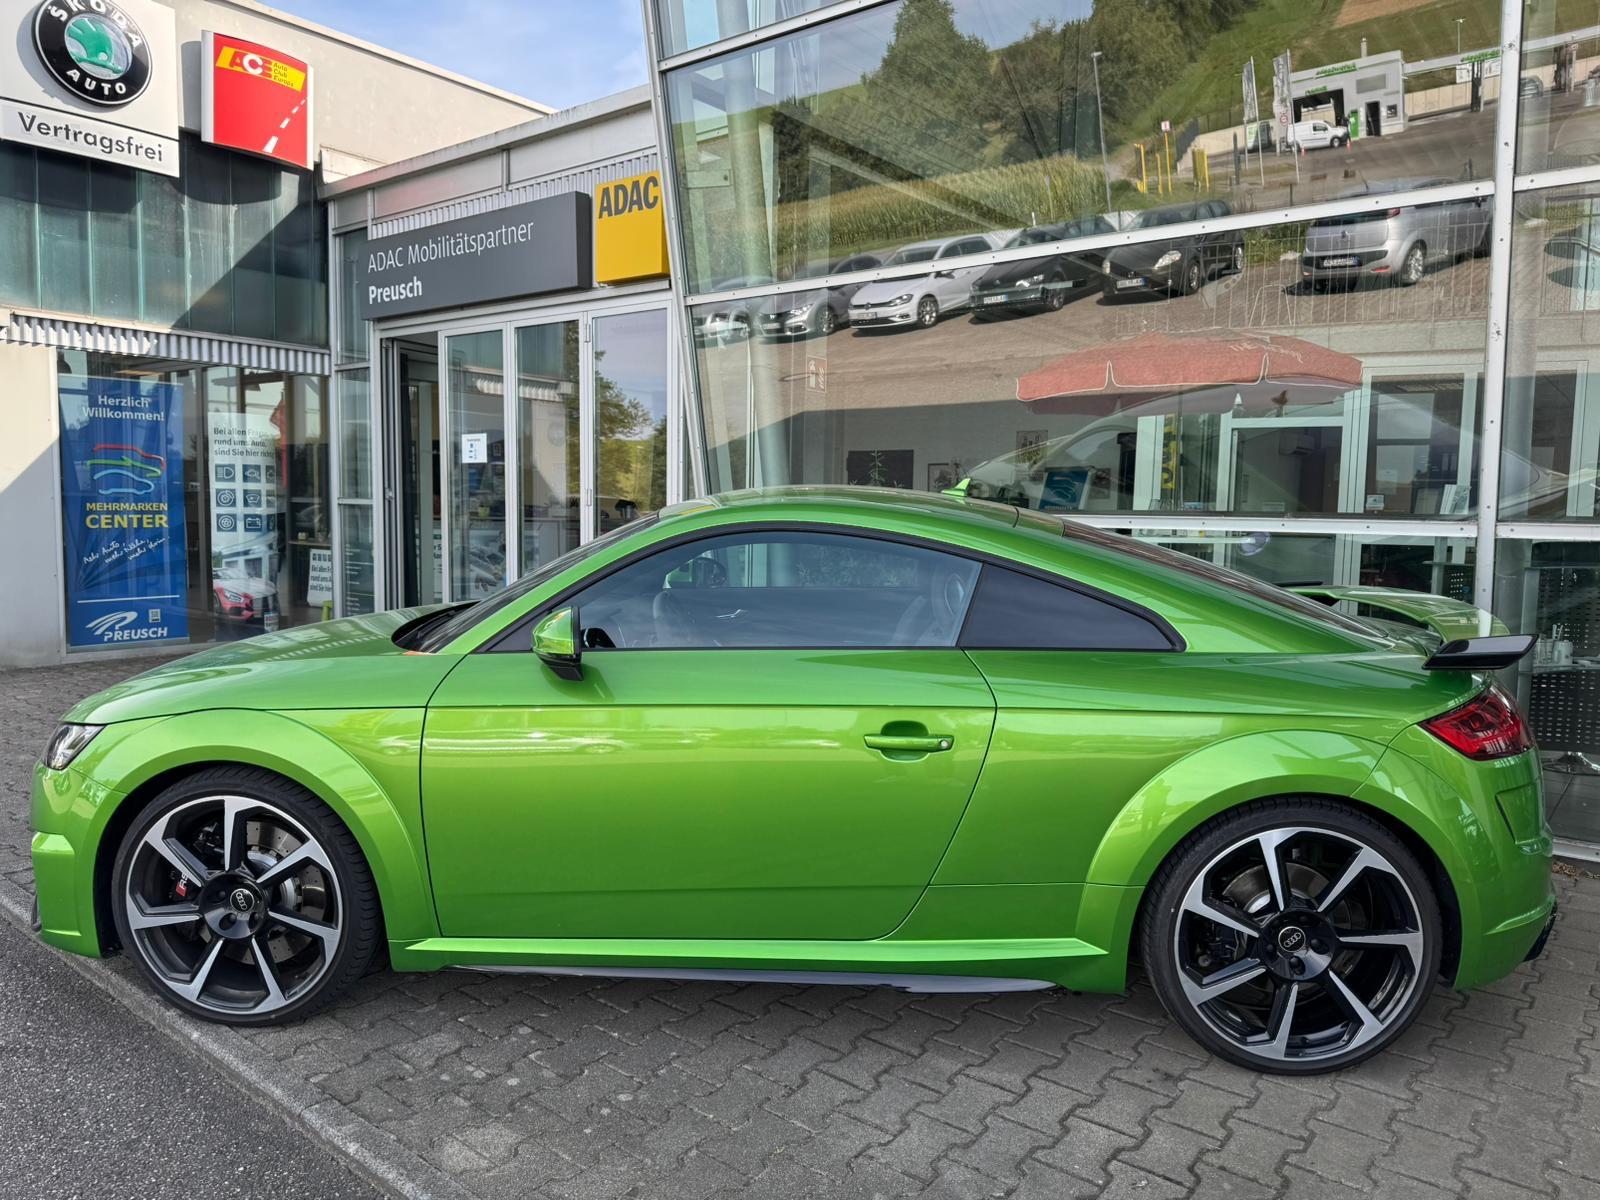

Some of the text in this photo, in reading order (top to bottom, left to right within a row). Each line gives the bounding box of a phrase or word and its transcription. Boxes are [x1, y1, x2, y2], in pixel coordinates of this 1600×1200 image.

[229, 50, 272, 79] ACE
[273, 62, 288, 72] Auto
[273, 69, 288, 78] Club
[66, 69, 127, 96] AUTO
[17, 111, 163, 163] Vertragsfrei
[598, 175, 659, 220] ADAC
[367, 220, 534, 273] ADAC Mobilitätspartner
[368, 276, 423, 305] Preusch
[97, 394, 150, 408] Herzlich
[82, 406, 165, 422] Willkommen!
[213, 427, 226, 435] Bei
[214, 438, 232, 446] rund
[214, 448, 231, 456] sind
[231, 449, 245, 457] Sie
[245, 449, 259, 457] hier
[86, 502, 168, 512] MEHRMARKEN
[86, 514, 169, 529] CENTER
[104, 627, 168, 642] PREUSCH
